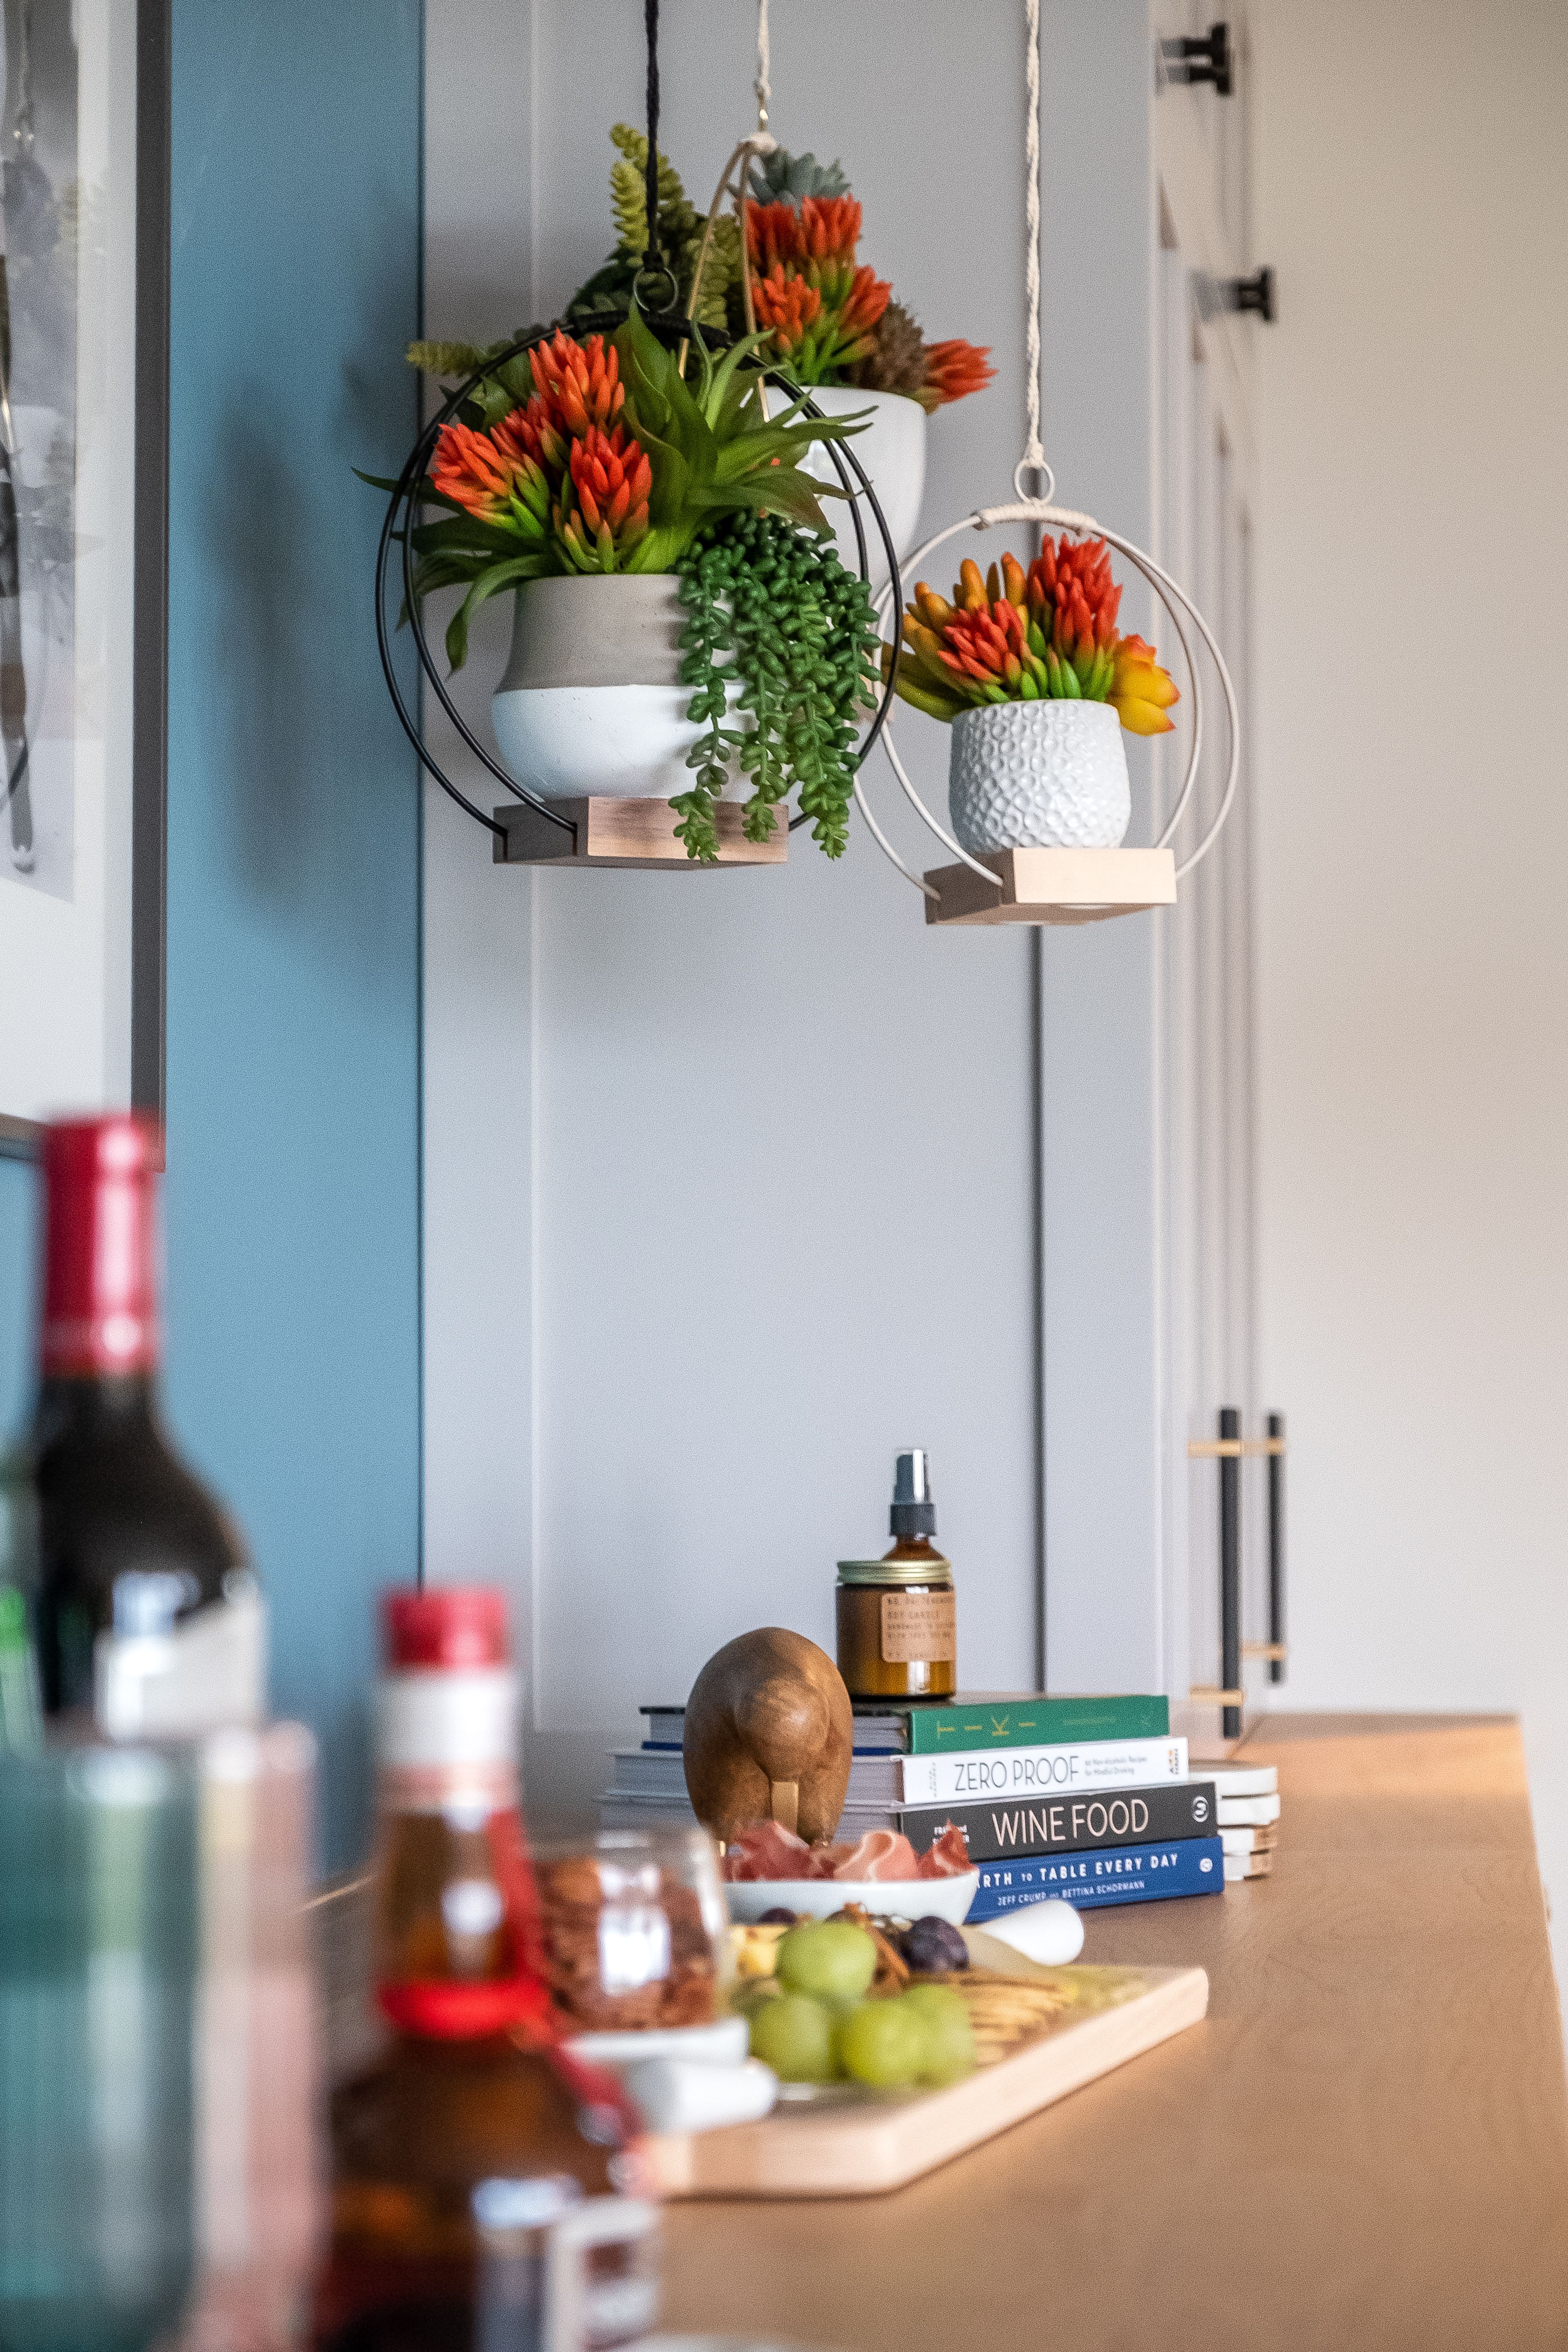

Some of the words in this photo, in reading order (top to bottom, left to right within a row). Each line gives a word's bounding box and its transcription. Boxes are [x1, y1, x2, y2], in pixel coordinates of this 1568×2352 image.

[954, 1761, 1007, 1791] ZERO
[1013, 1755, 1079, 1786] PROOF
[991, 1806, 1066, 1846] WINE
[1072, 1799, 1149, 1839] FOOD
[1039, 1863, 1087, 1881] TABLE
[1095, 1857, 1142, 1875] EVERY
[1150, 1853, 1178, 1869] DAY
[1061, 1886, 1095, 1899] BETTINA
[1096, 1880, 1145, 1895] SCHORMANN
